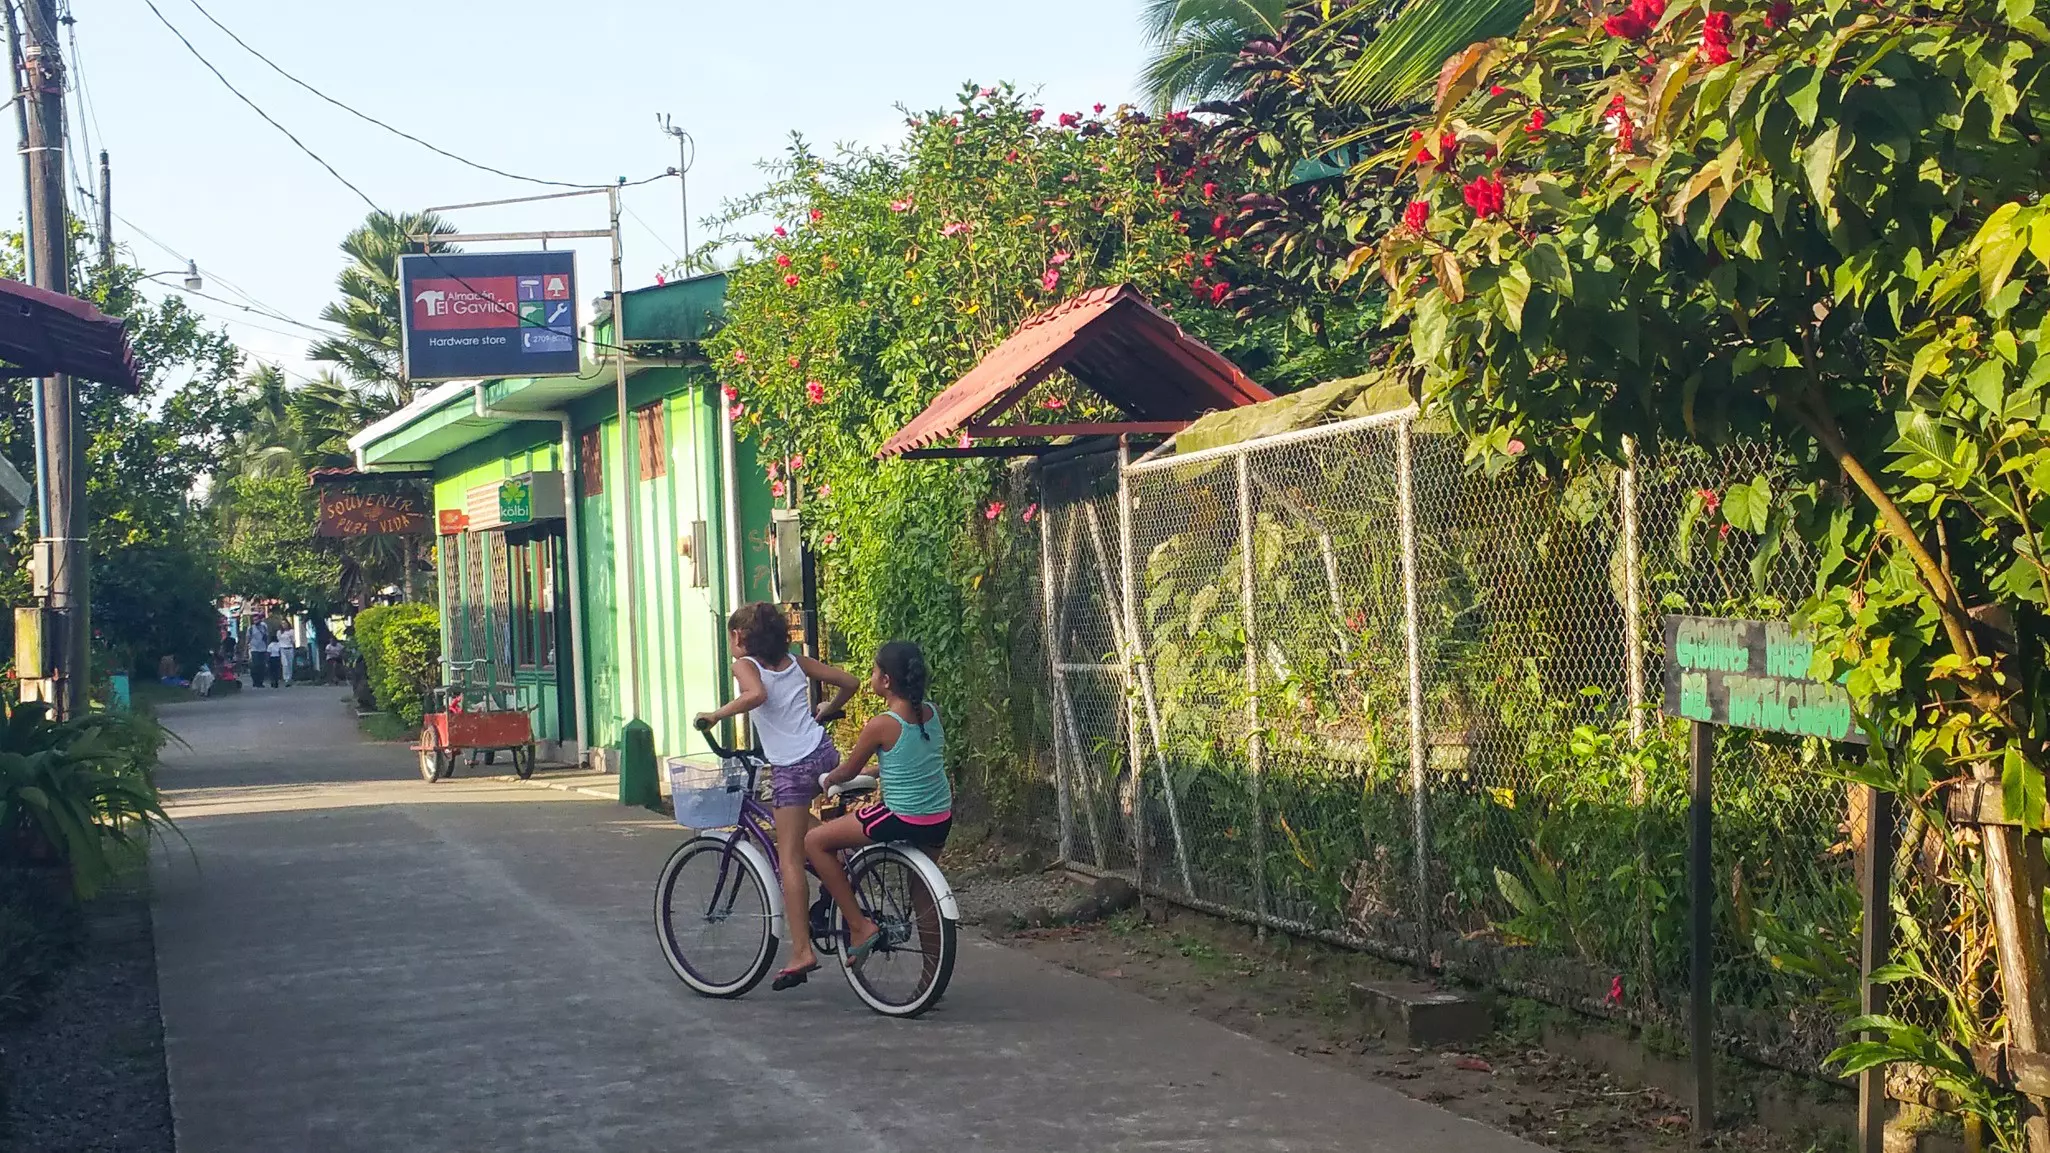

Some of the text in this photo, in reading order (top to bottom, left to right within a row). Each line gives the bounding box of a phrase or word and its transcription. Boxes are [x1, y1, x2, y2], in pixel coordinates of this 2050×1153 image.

[436, 299, 516, 315] El Gavilán
[429, 335, 507, 347] Hardware store
[327, 493, 413, 519] SOUVENIR
[500, 505, 529, 517] kölbi
[380, 514, 410, 533] VIDA
[1680, 672, 1851, 739] DEL TORTUGUERO
